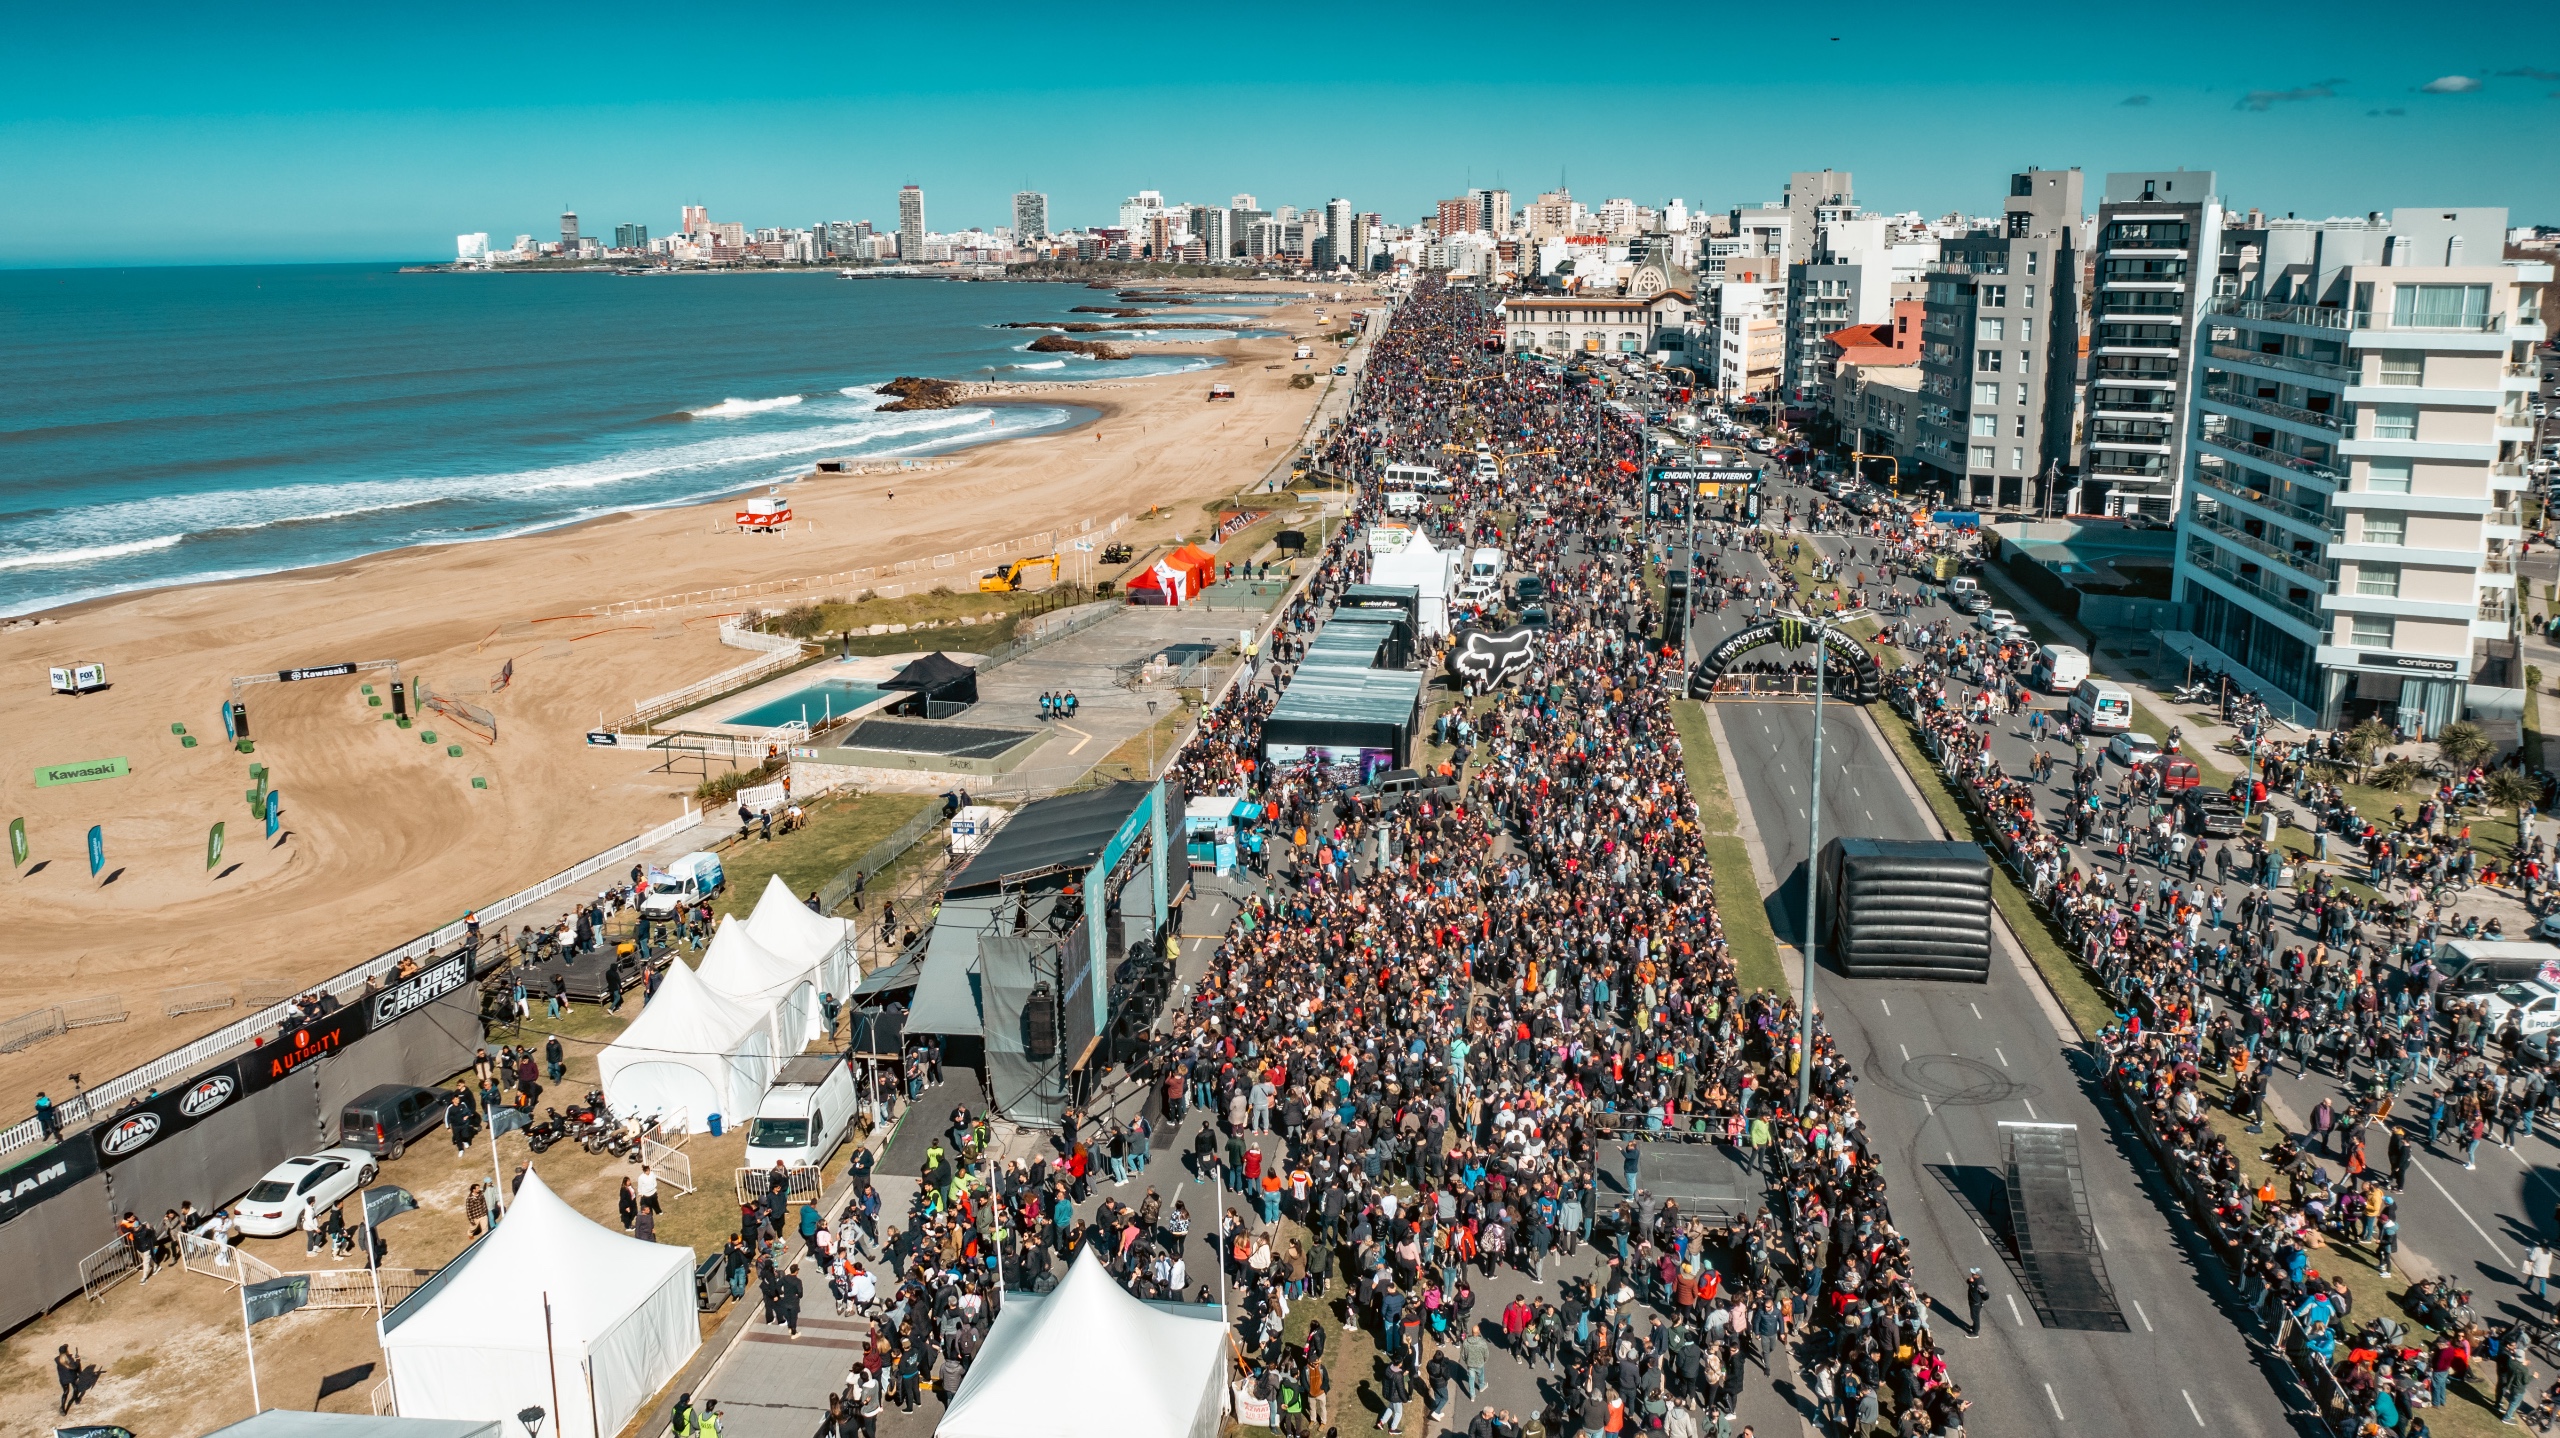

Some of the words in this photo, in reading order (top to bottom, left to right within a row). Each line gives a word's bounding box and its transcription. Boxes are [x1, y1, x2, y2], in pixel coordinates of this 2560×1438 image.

[1663, 471, 1696, 480] ENDURO
[1696, 471, 1711, 480] DEL
[1711, 472, 1753, 480] INVIERNO
[1718, 627, 1773, 659] MONSTER
[1731, 639, 1766, 659] ENERGY
[52, 673, 64, 681] FOX
[79, 671, 94, 679] FOX
[96, 669, 102, 680] 2
[302, 666, 348, 679] Kawasaki
[2397, 659, 2453, 669] contempo
[48, 763, 116, 781] Kawasaki
[397, 957, 465, 1000] GLOBAL
[395, 976, 453, 1014] PARTS
[272, 1028, 340, 1077] AUTOCITY
[186, 1079, 230, 1112] Airoh
[107, 1116, 157, 1151] Airoh
[0, 1160, 67, 1204] RAM
